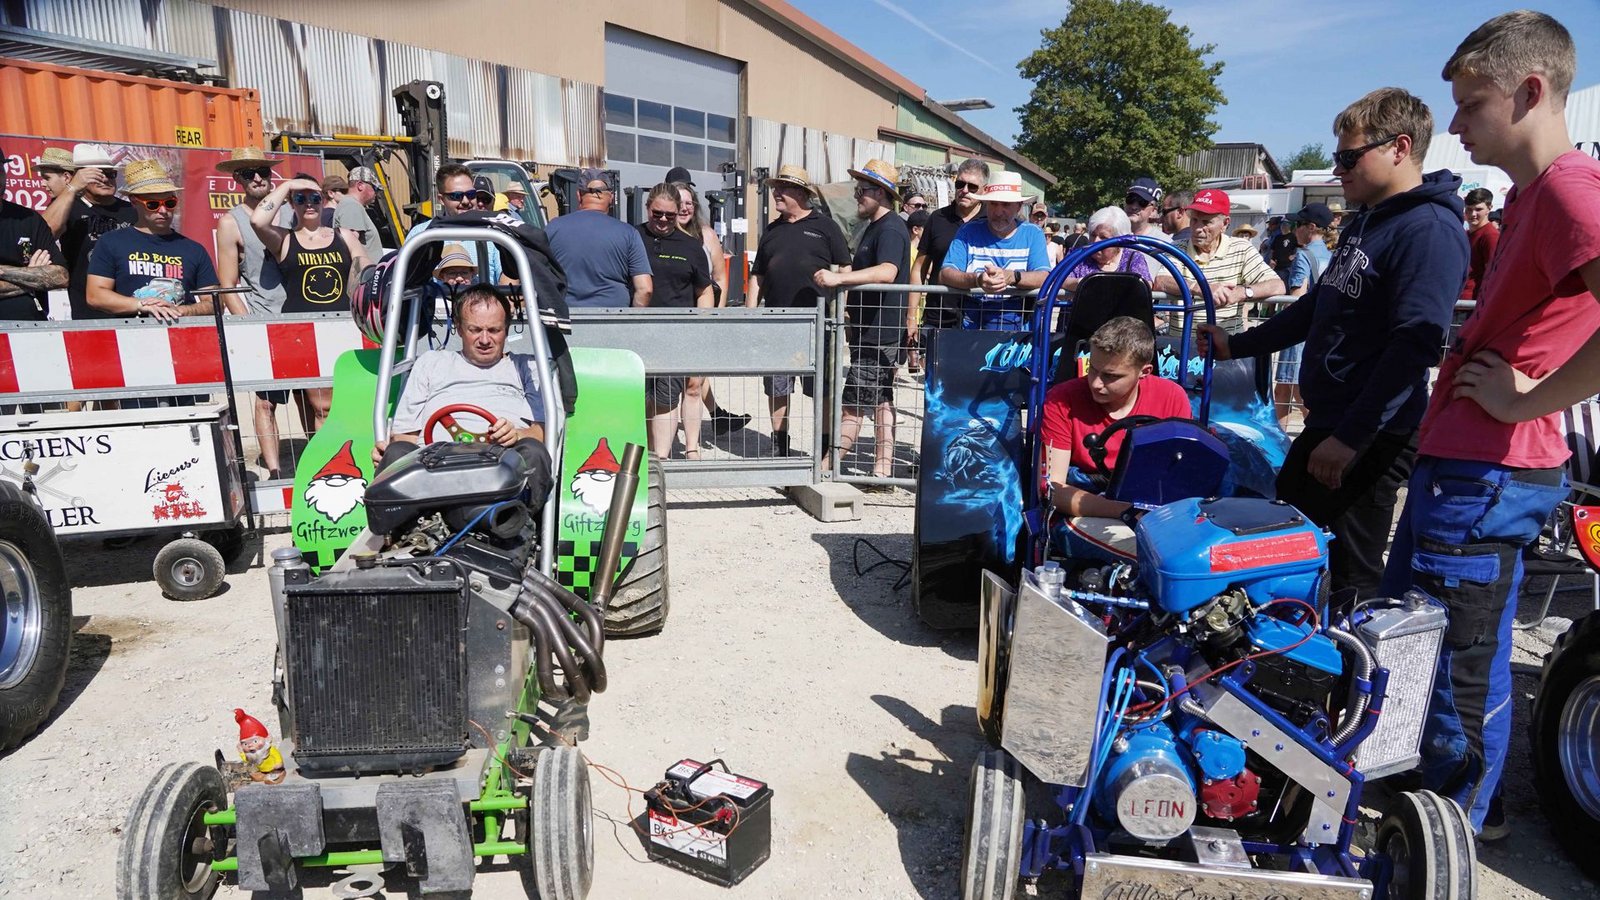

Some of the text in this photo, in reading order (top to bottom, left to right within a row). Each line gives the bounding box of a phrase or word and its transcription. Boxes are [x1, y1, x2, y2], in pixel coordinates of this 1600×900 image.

[176, 129, 202, 145] REAR
[128, 251, 182, 266] OLD BUGS
[297, 251, 343, 266] NIRVANA
[128, 260, 184, 279] NEVER DIE
[143, 456, 200, 493] License
[296, 519, 366, 544] Giftzwer
